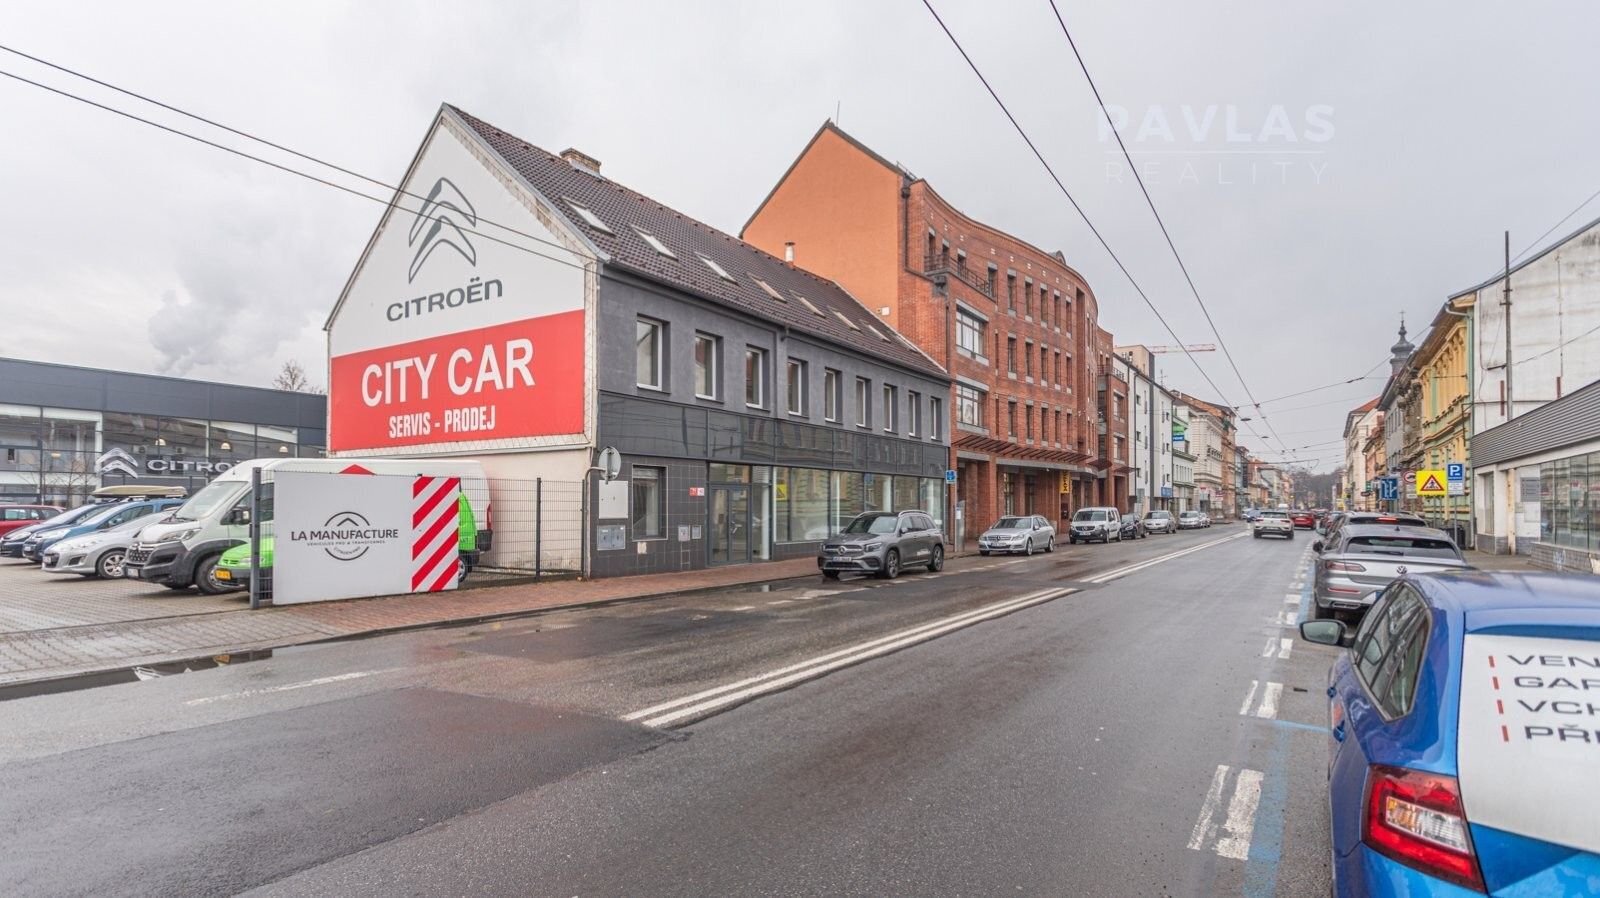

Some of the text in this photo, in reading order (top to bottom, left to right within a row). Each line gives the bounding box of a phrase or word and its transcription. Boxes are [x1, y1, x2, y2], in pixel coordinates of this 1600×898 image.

[361, 338, 536, 408] CITY CAR
[389, 411, 432, 439] SERVIS
[444, 405, 496, 433] PRODEJ
[147, 459, 240, 473] CITRO
[291, 529, 399, 541] LA MANUFACTURE
